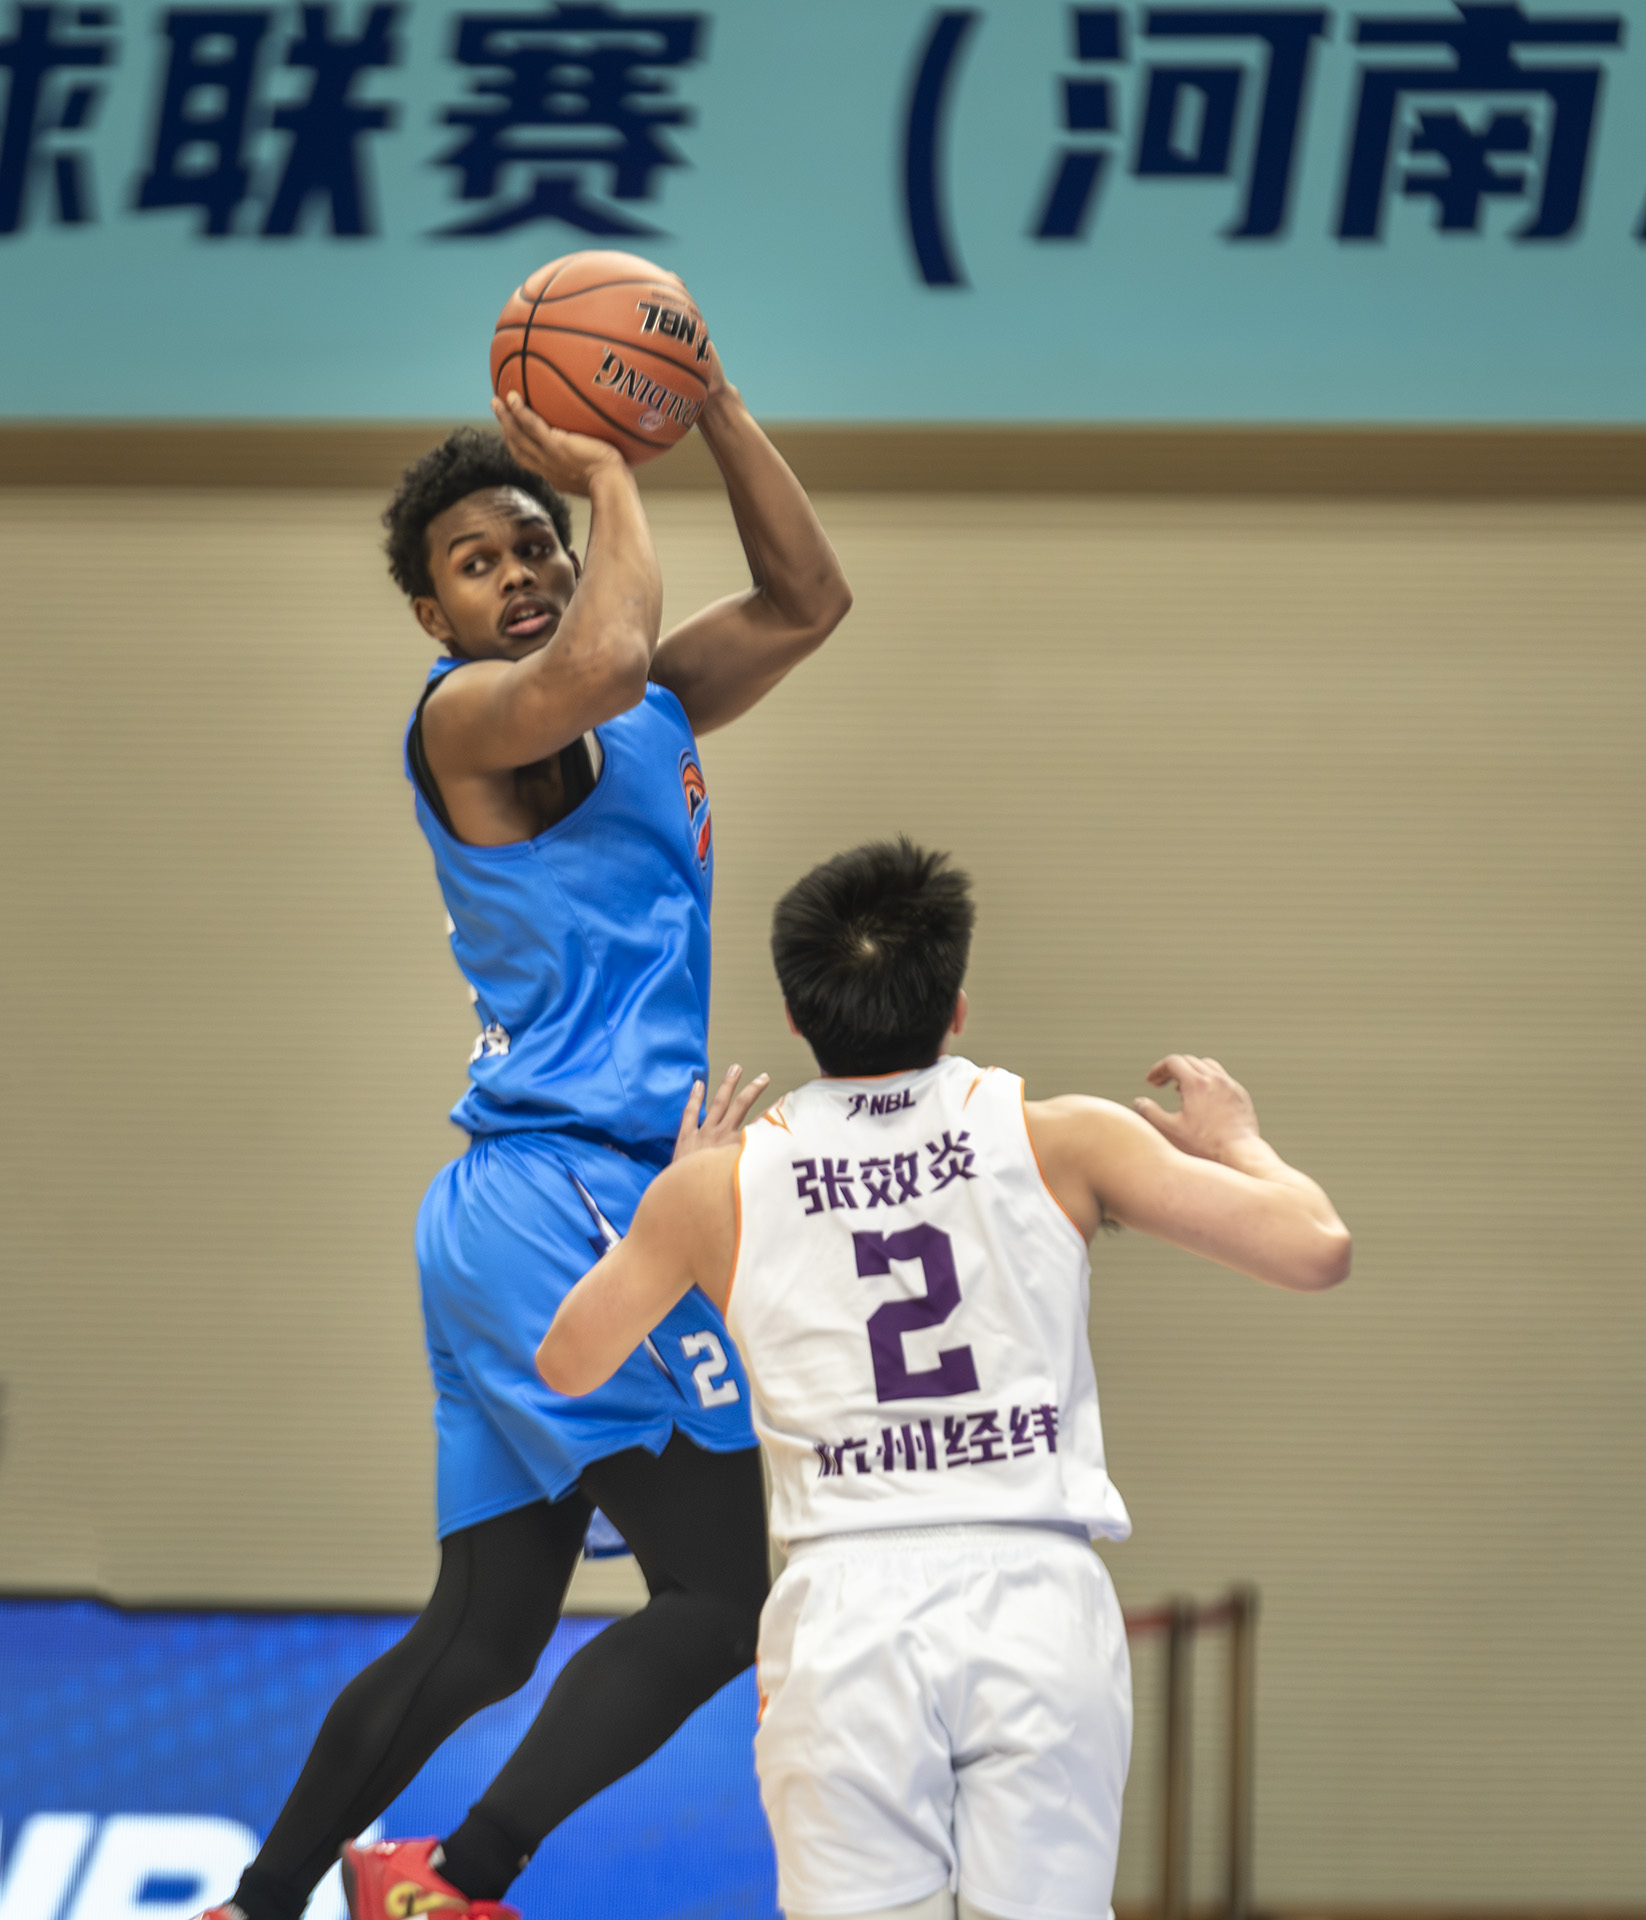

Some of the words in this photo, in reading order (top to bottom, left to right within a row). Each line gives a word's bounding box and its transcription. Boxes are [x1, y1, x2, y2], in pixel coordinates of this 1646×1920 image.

[636, 300, 698, 348] NBL
[593, 346, 704, 429] PALDING
[870, 1088, 917, 1117] NBL
[792, 1130, 979, 1216] 张效炎
[851, 1221, 981, 1404] 2
[680, 1329, 740, 1408] 2
